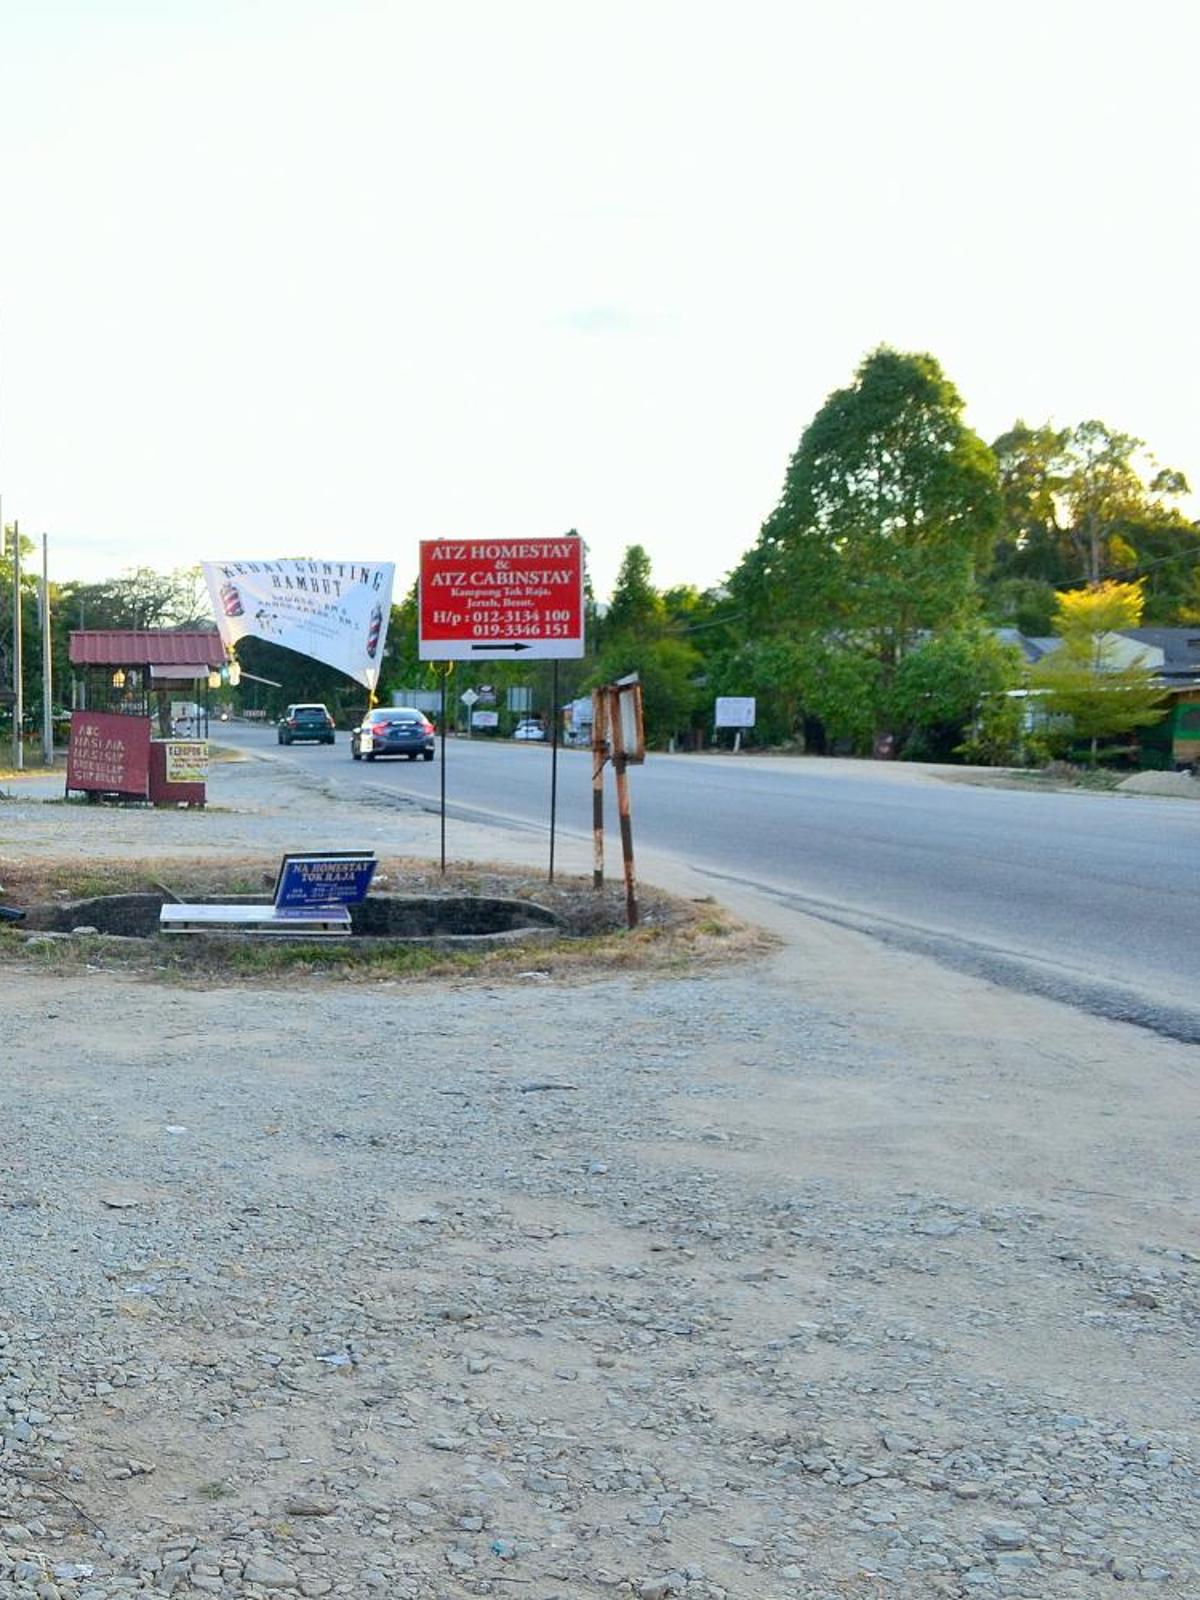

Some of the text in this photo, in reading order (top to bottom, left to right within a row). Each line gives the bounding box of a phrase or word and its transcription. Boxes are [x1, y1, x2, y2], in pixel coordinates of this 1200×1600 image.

[431, 544, 573, 561] ATZ HOMESTAY
[494, 560, 511, 570] &
[431, 570, 573, 586] ATZ CABINSTAY
[433, 611, 461, 626] H/p
[545, 609, 570, 622] 100
[545, 623, 569, 636] 151
